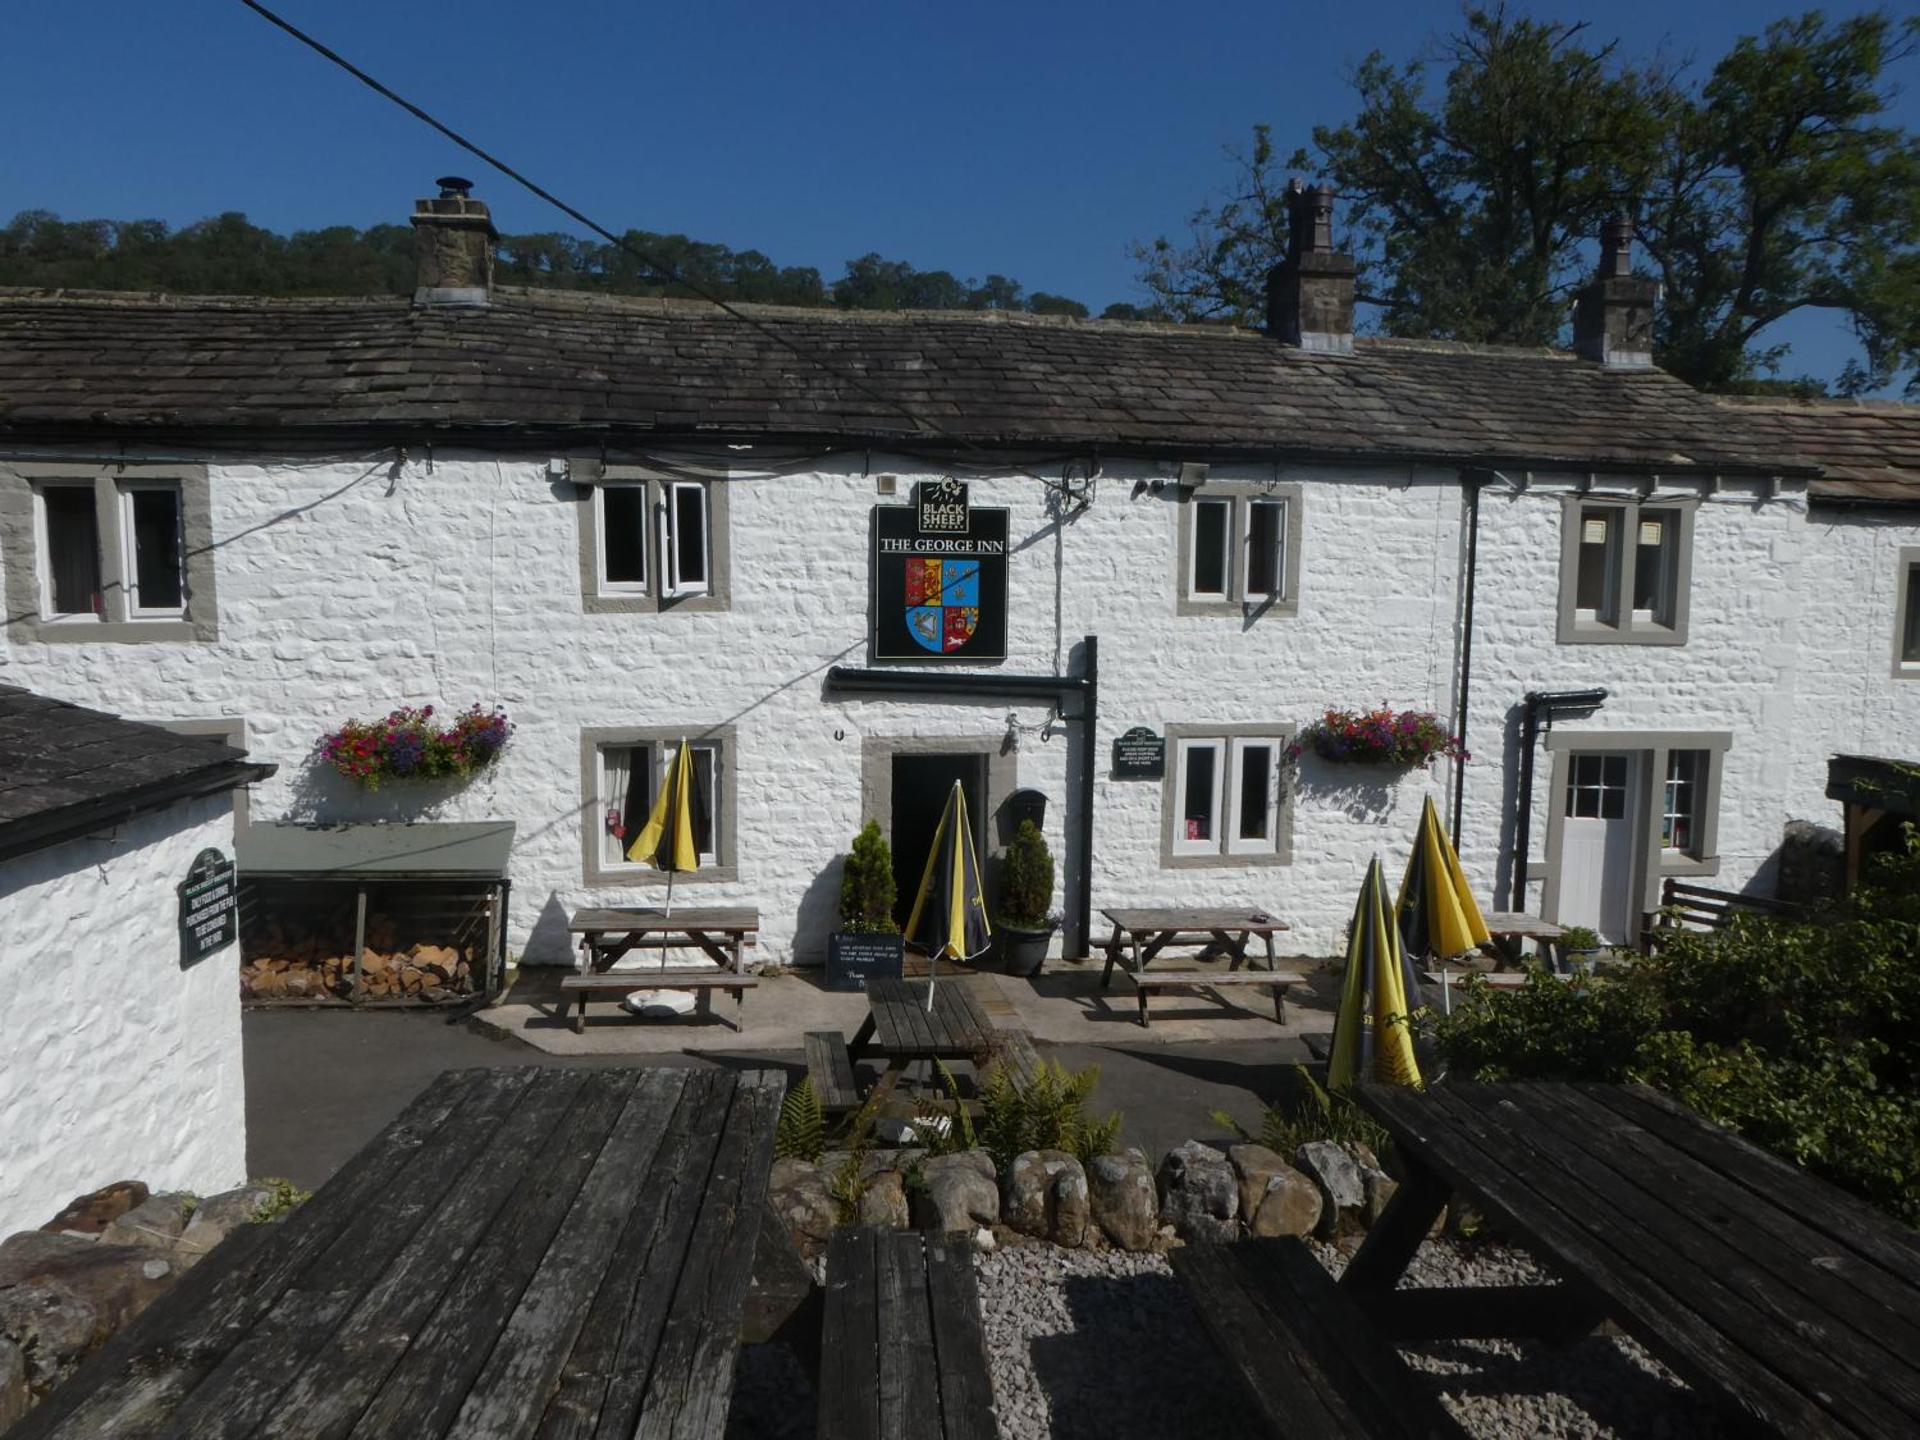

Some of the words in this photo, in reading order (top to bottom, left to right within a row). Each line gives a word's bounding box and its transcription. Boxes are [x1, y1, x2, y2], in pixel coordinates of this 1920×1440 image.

[923, 504, 964, 514] BLACK
[923, 514, 964, 525] SHEEP
[880, 538, 911, 550] THE
[915, 539, 973, 551] GEORGE
[977, 540, 1004, 552] INN
